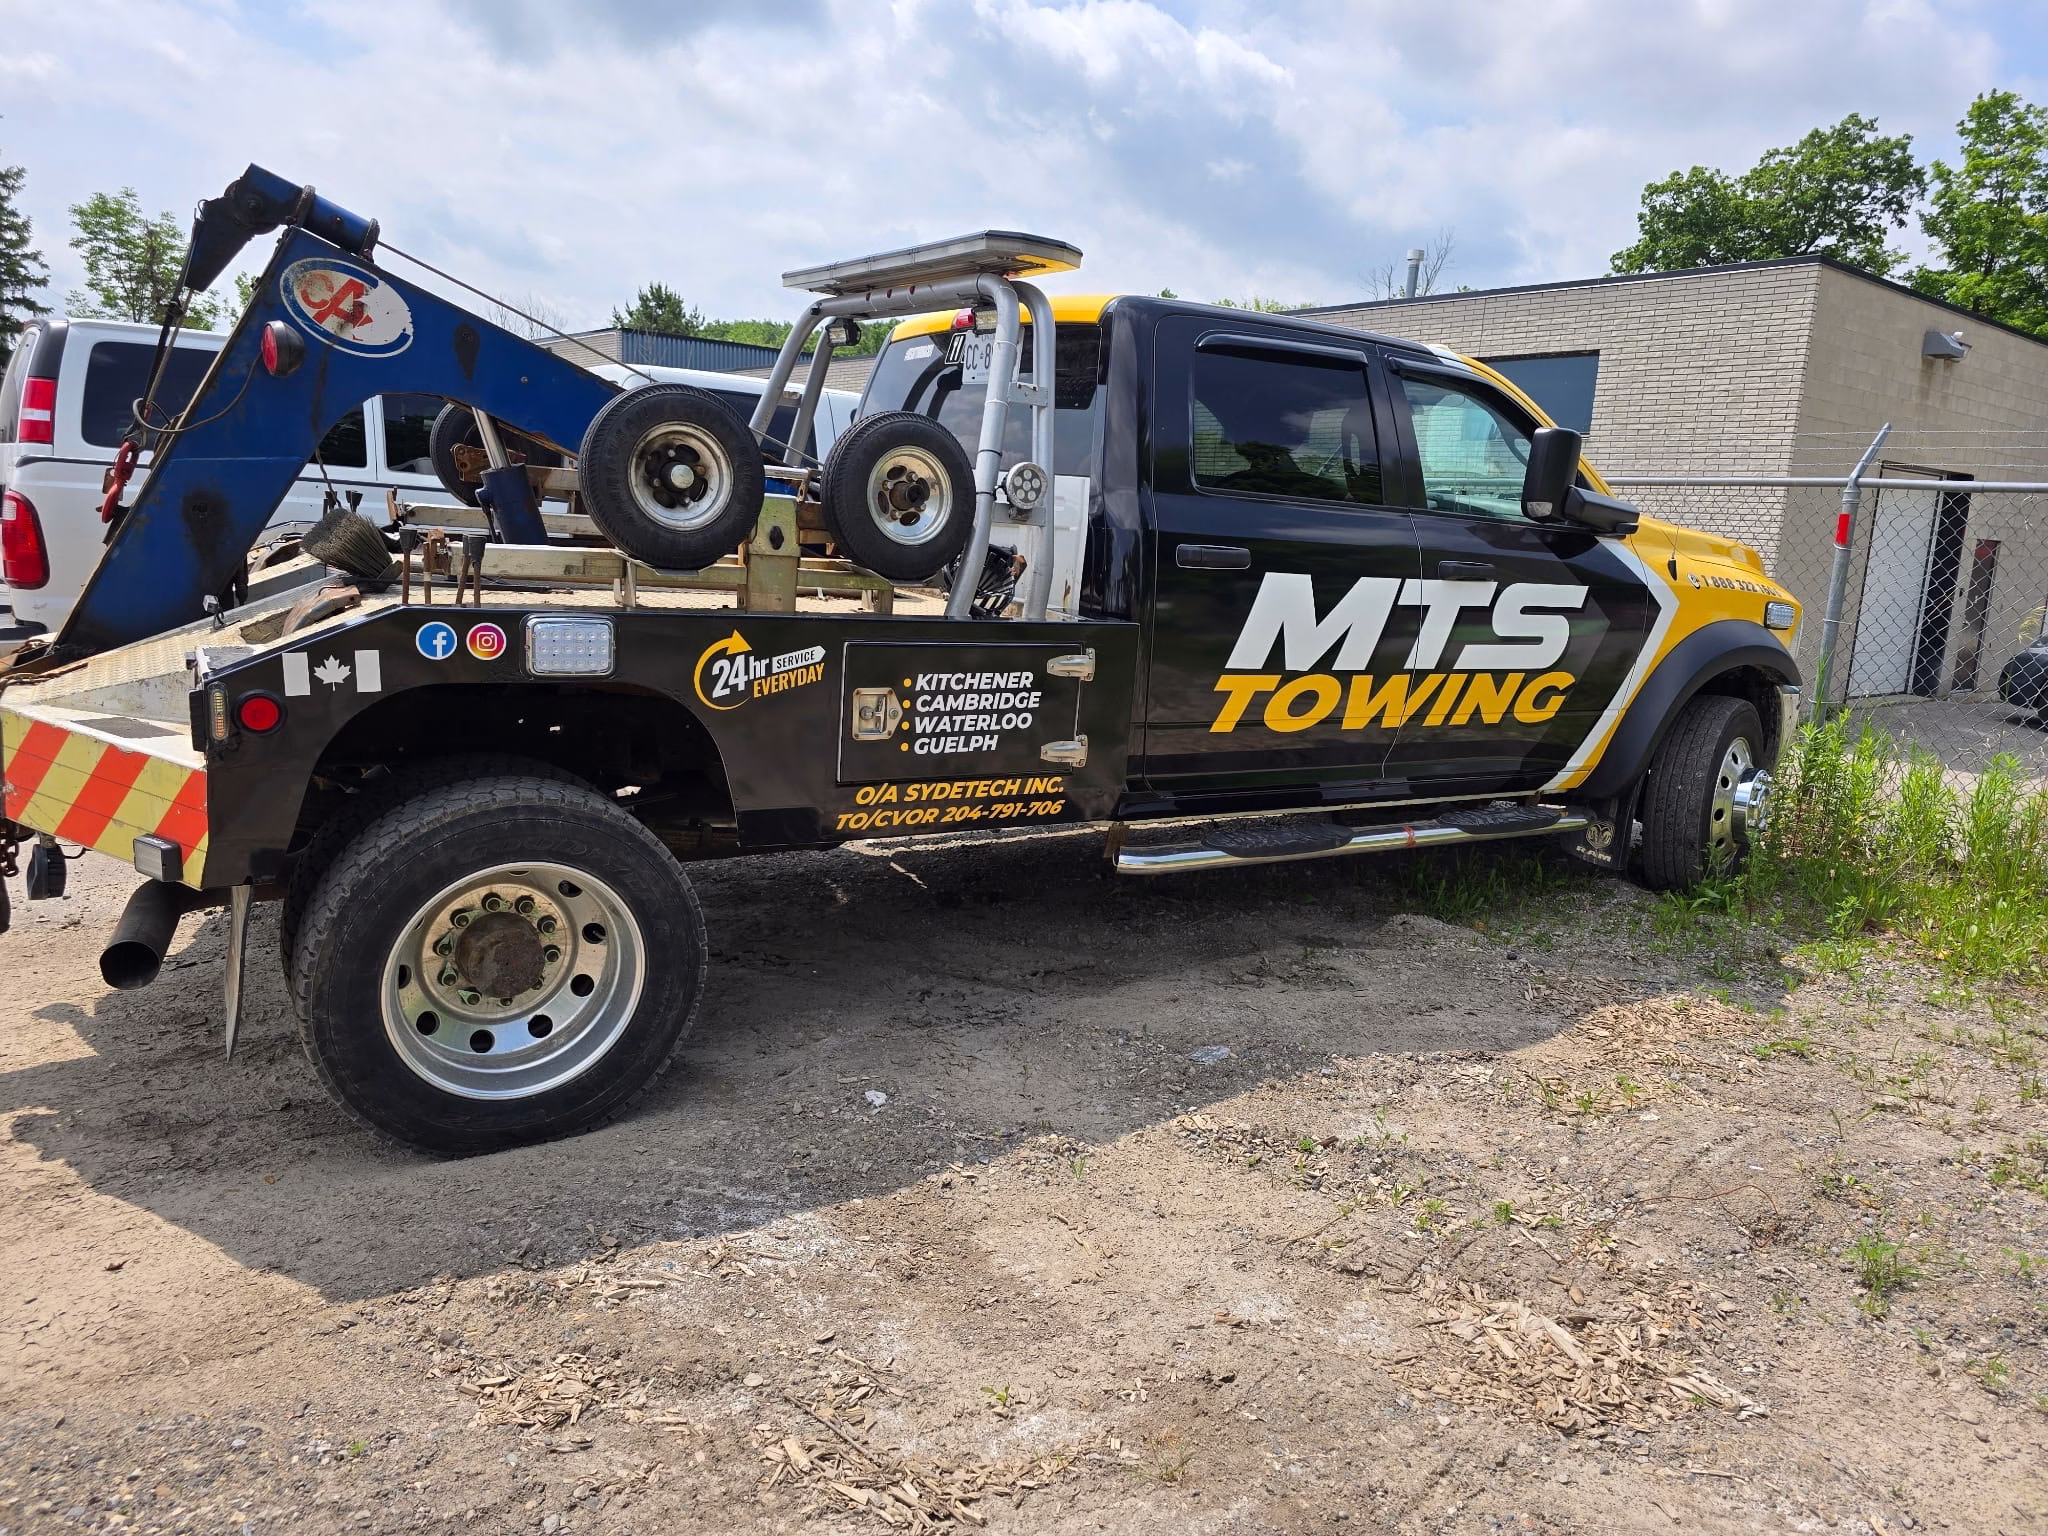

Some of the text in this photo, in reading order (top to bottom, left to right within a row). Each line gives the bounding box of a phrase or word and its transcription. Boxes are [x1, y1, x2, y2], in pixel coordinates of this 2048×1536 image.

[1710, 575, 1736, 590] 888
[1736, 579, 1758, 593] 322
[1225, 571, 1590, 672] MTS
[776, 649, 816, 670] SERVICE
[753, 663, 825, 699] EVERYDAY
[915, 672, 1034, 691] KITCHENER
[916, 691, 1041, 712] CAMBRIDGE
[1208, 671, 1577, 733] TOWING
[914, 712, 1033, 734] WATERLOO
[914, 734, 999, 755] GUELPH
[855, 776, 1065, 806] O/A SYDETECH INC.
[835, 799, 1066, 832] TO/CVOR 204-791-706
[1576, 845, 1612, 863] RAM
